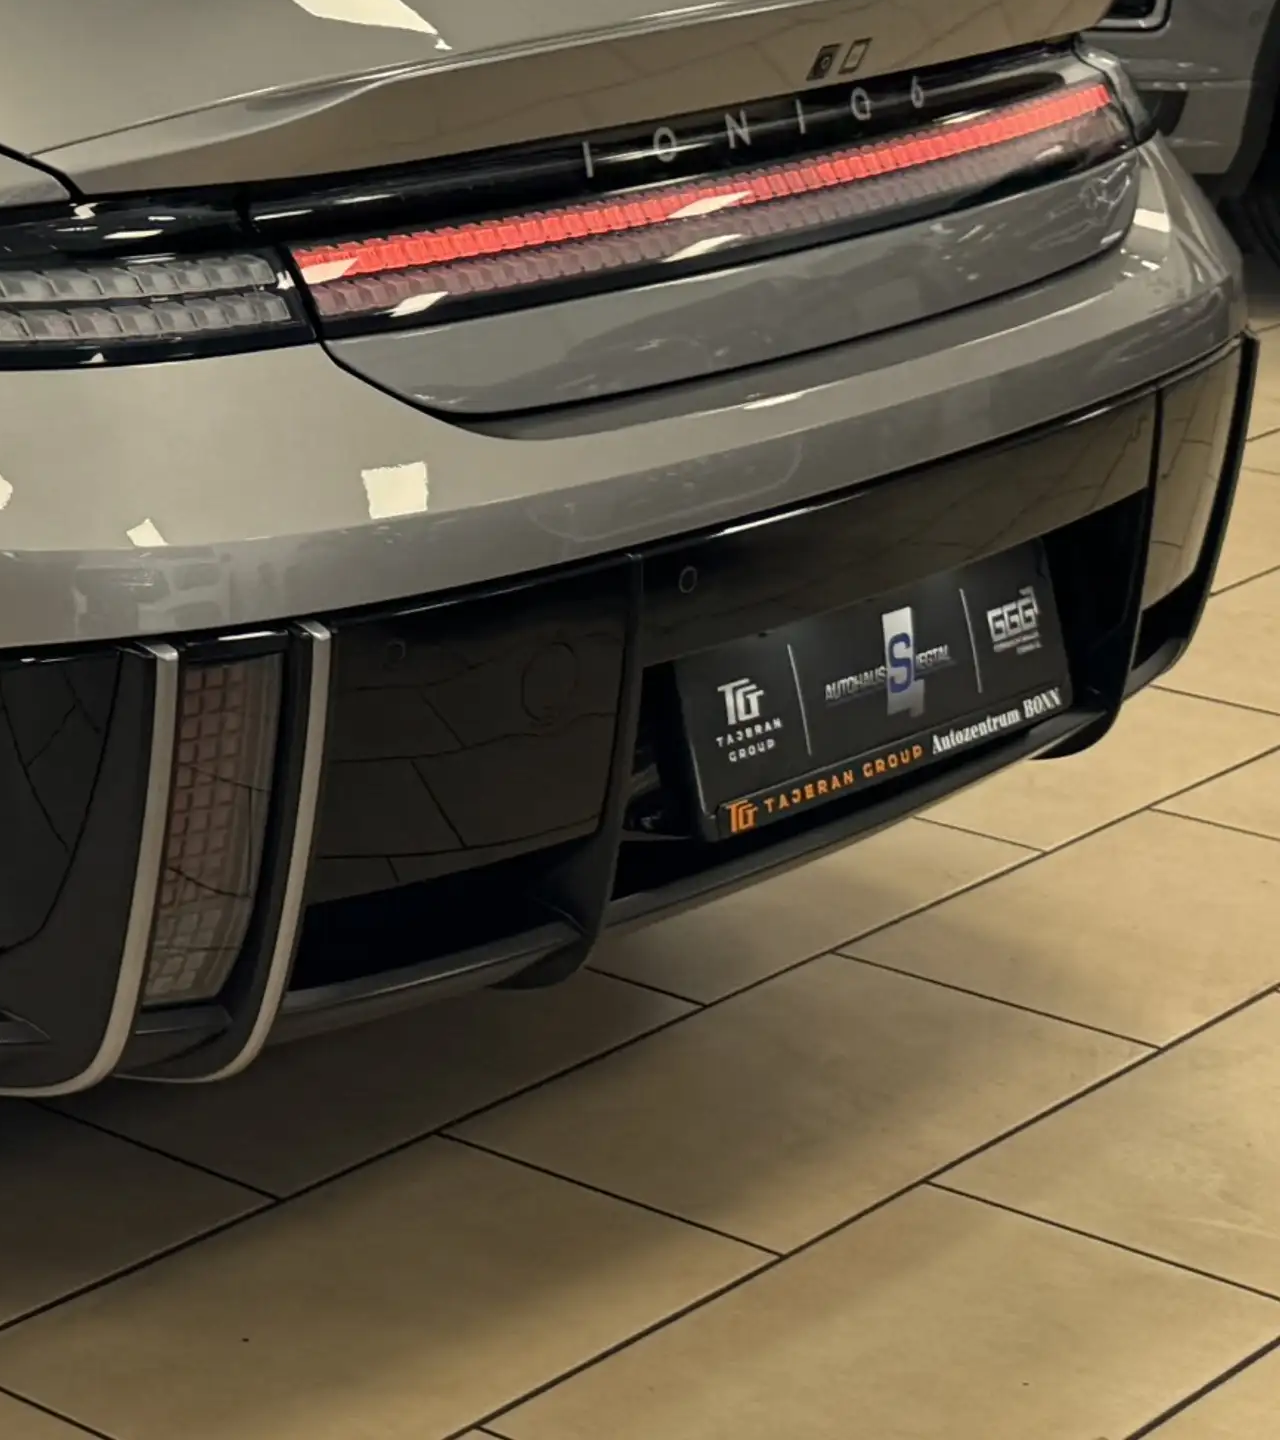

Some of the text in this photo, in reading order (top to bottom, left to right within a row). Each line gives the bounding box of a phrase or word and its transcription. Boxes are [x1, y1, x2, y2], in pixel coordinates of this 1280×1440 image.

[583, 75, 925, 178] IONIQ 6
[715, 717, 784, 748] TAJERAN
[728, 737, 777, 764] GROUP
[762, 768, 855, 814] TAJERAN
[861, 744, 924, 779] GROUP
[931, 707, 1022, 756] Autozentrum
